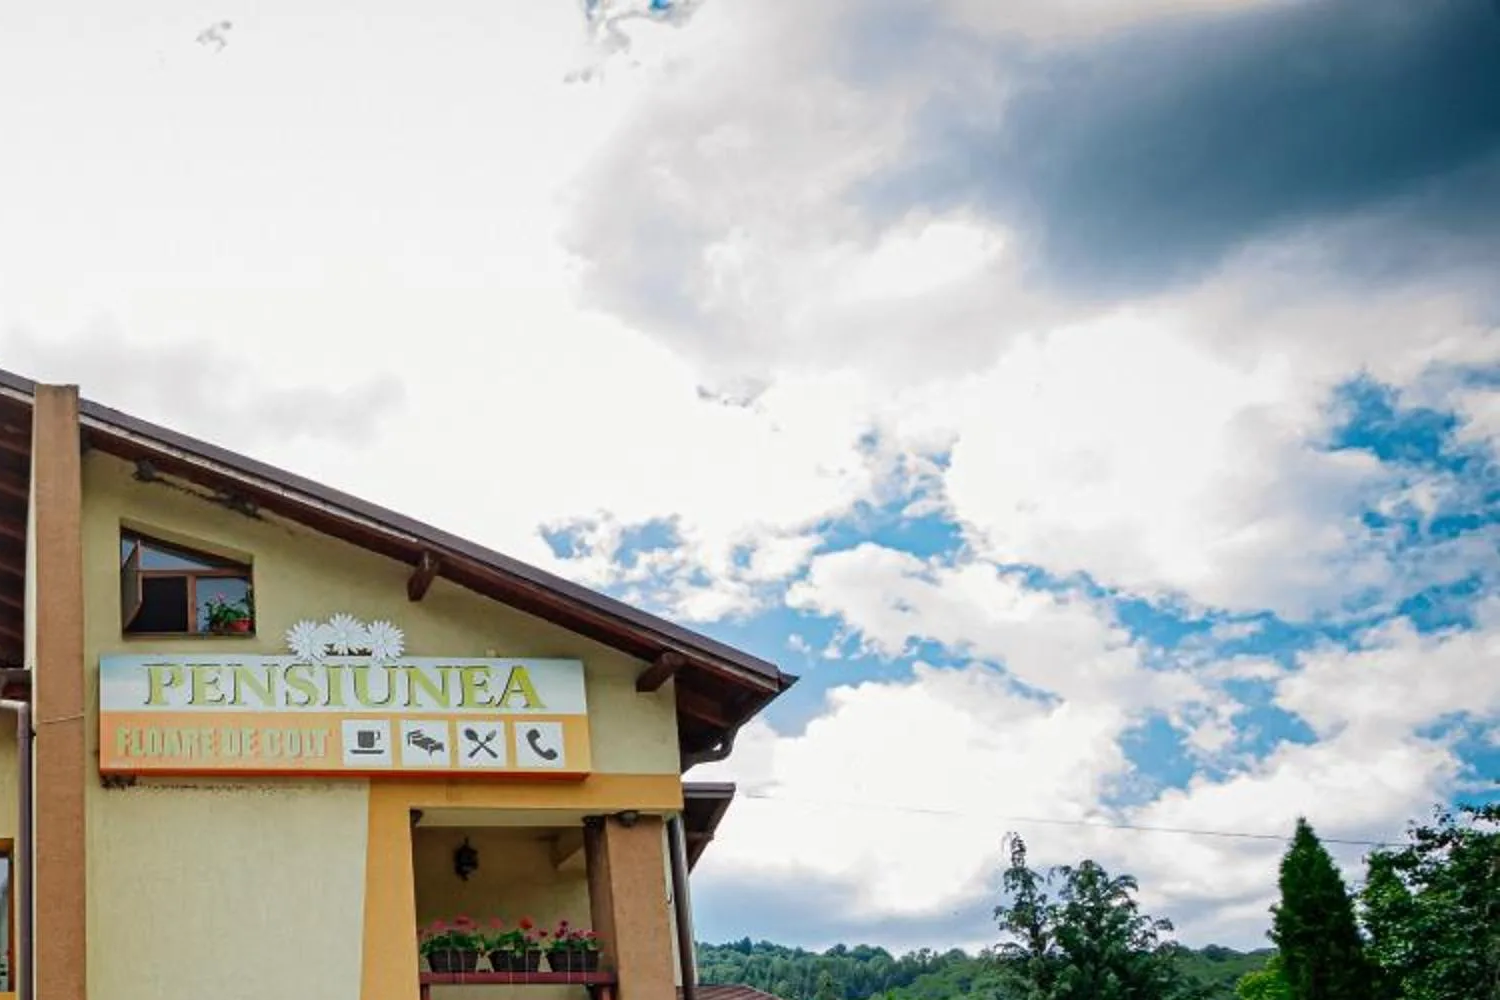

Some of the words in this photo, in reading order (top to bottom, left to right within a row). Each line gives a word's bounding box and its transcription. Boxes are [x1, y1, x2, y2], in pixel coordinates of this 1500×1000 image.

[140, 663, 547, 709] PENSIUNEA
[116, 725, 219, 759] FLOARE
[221, 726, 258, 758] DE
